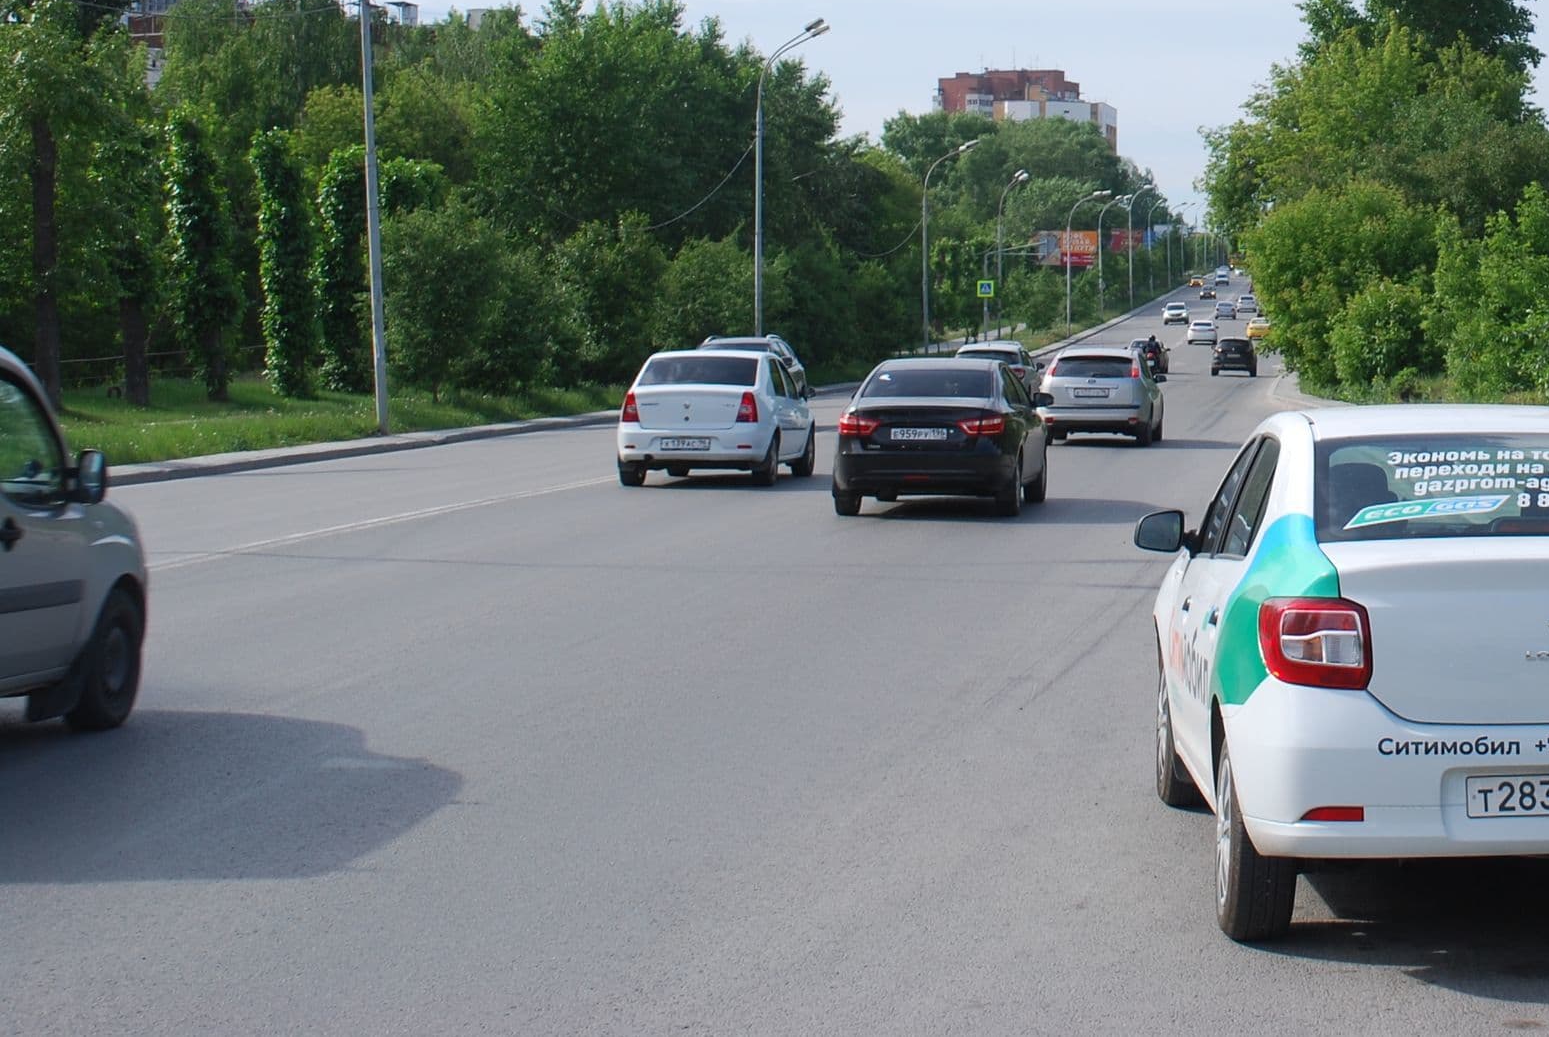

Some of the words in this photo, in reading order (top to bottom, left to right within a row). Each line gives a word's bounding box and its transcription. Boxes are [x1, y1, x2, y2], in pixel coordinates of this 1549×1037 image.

[1387, 451, 1490, 465] Экономь
[1497, 450, 1525, 463] на
[1395, 463, 1511, 480] переходи
[1516, 463, 1544, 475] на
[1517, 493, 1530, 508] 8
[1377, 737, 1521, 755] Ситимобил
